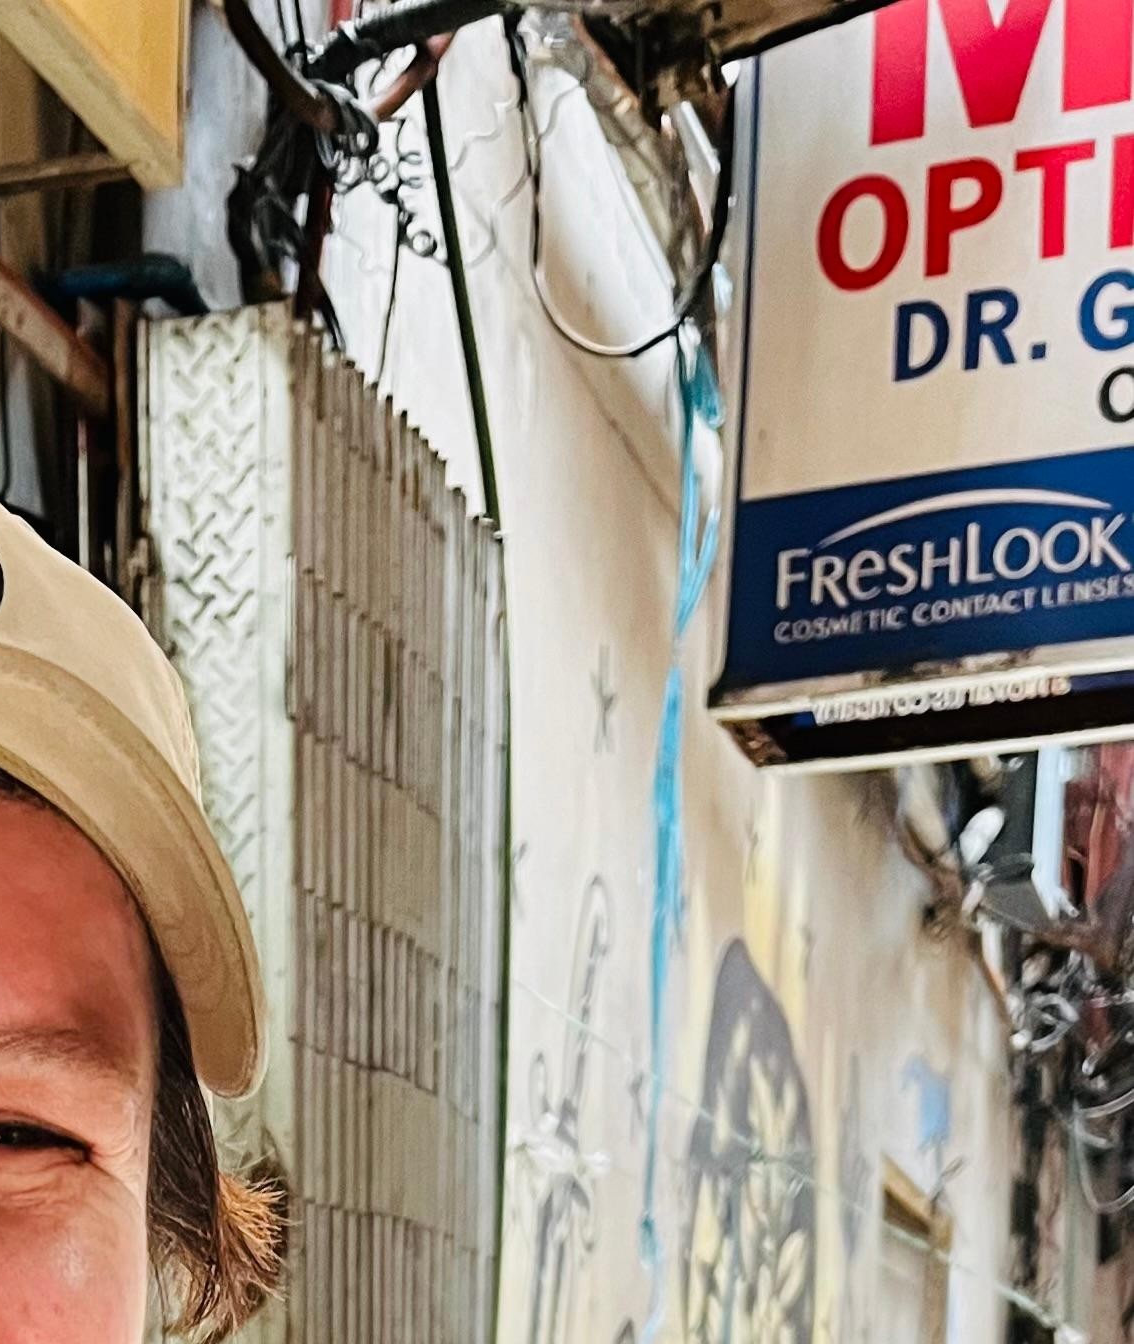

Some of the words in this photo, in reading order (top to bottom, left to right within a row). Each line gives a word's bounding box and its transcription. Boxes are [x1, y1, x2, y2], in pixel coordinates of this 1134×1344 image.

[817, 132, 1134, 292] OPTI
[893, 287, 1048, 383] DR.
[774, 605, 908, 644] COSMETIC
[912, 584, 1035, 628] CONTACT
[1041, 573, 1134, 610] LENSES
